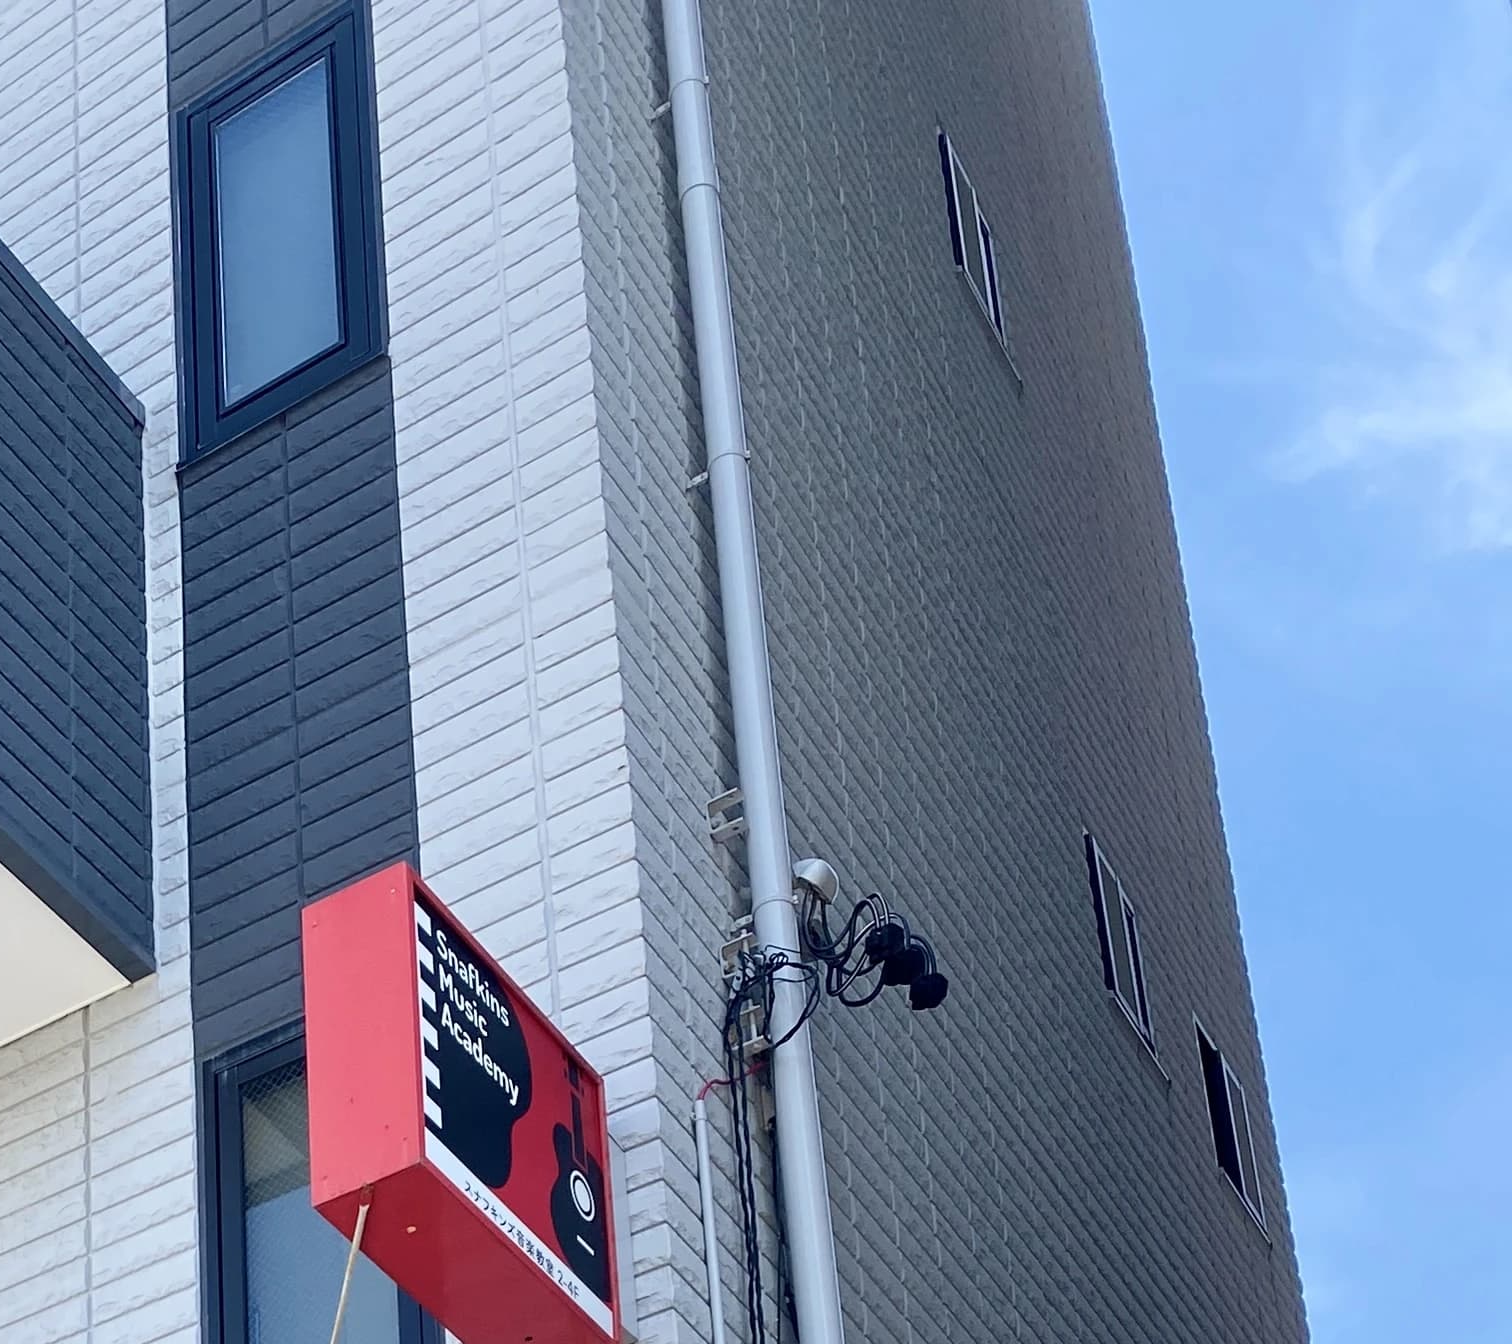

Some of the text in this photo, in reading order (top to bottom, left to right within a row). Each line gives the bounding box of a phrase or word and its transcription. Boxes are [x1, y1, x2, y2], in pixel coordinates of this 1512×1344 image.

[434, 928, 511, 1028] Snafkins
[438, 968, 490, 1038] Music
[440, 1004, 520, 1107] Academy
[556, 1268, 581, 1300] 2-4F
